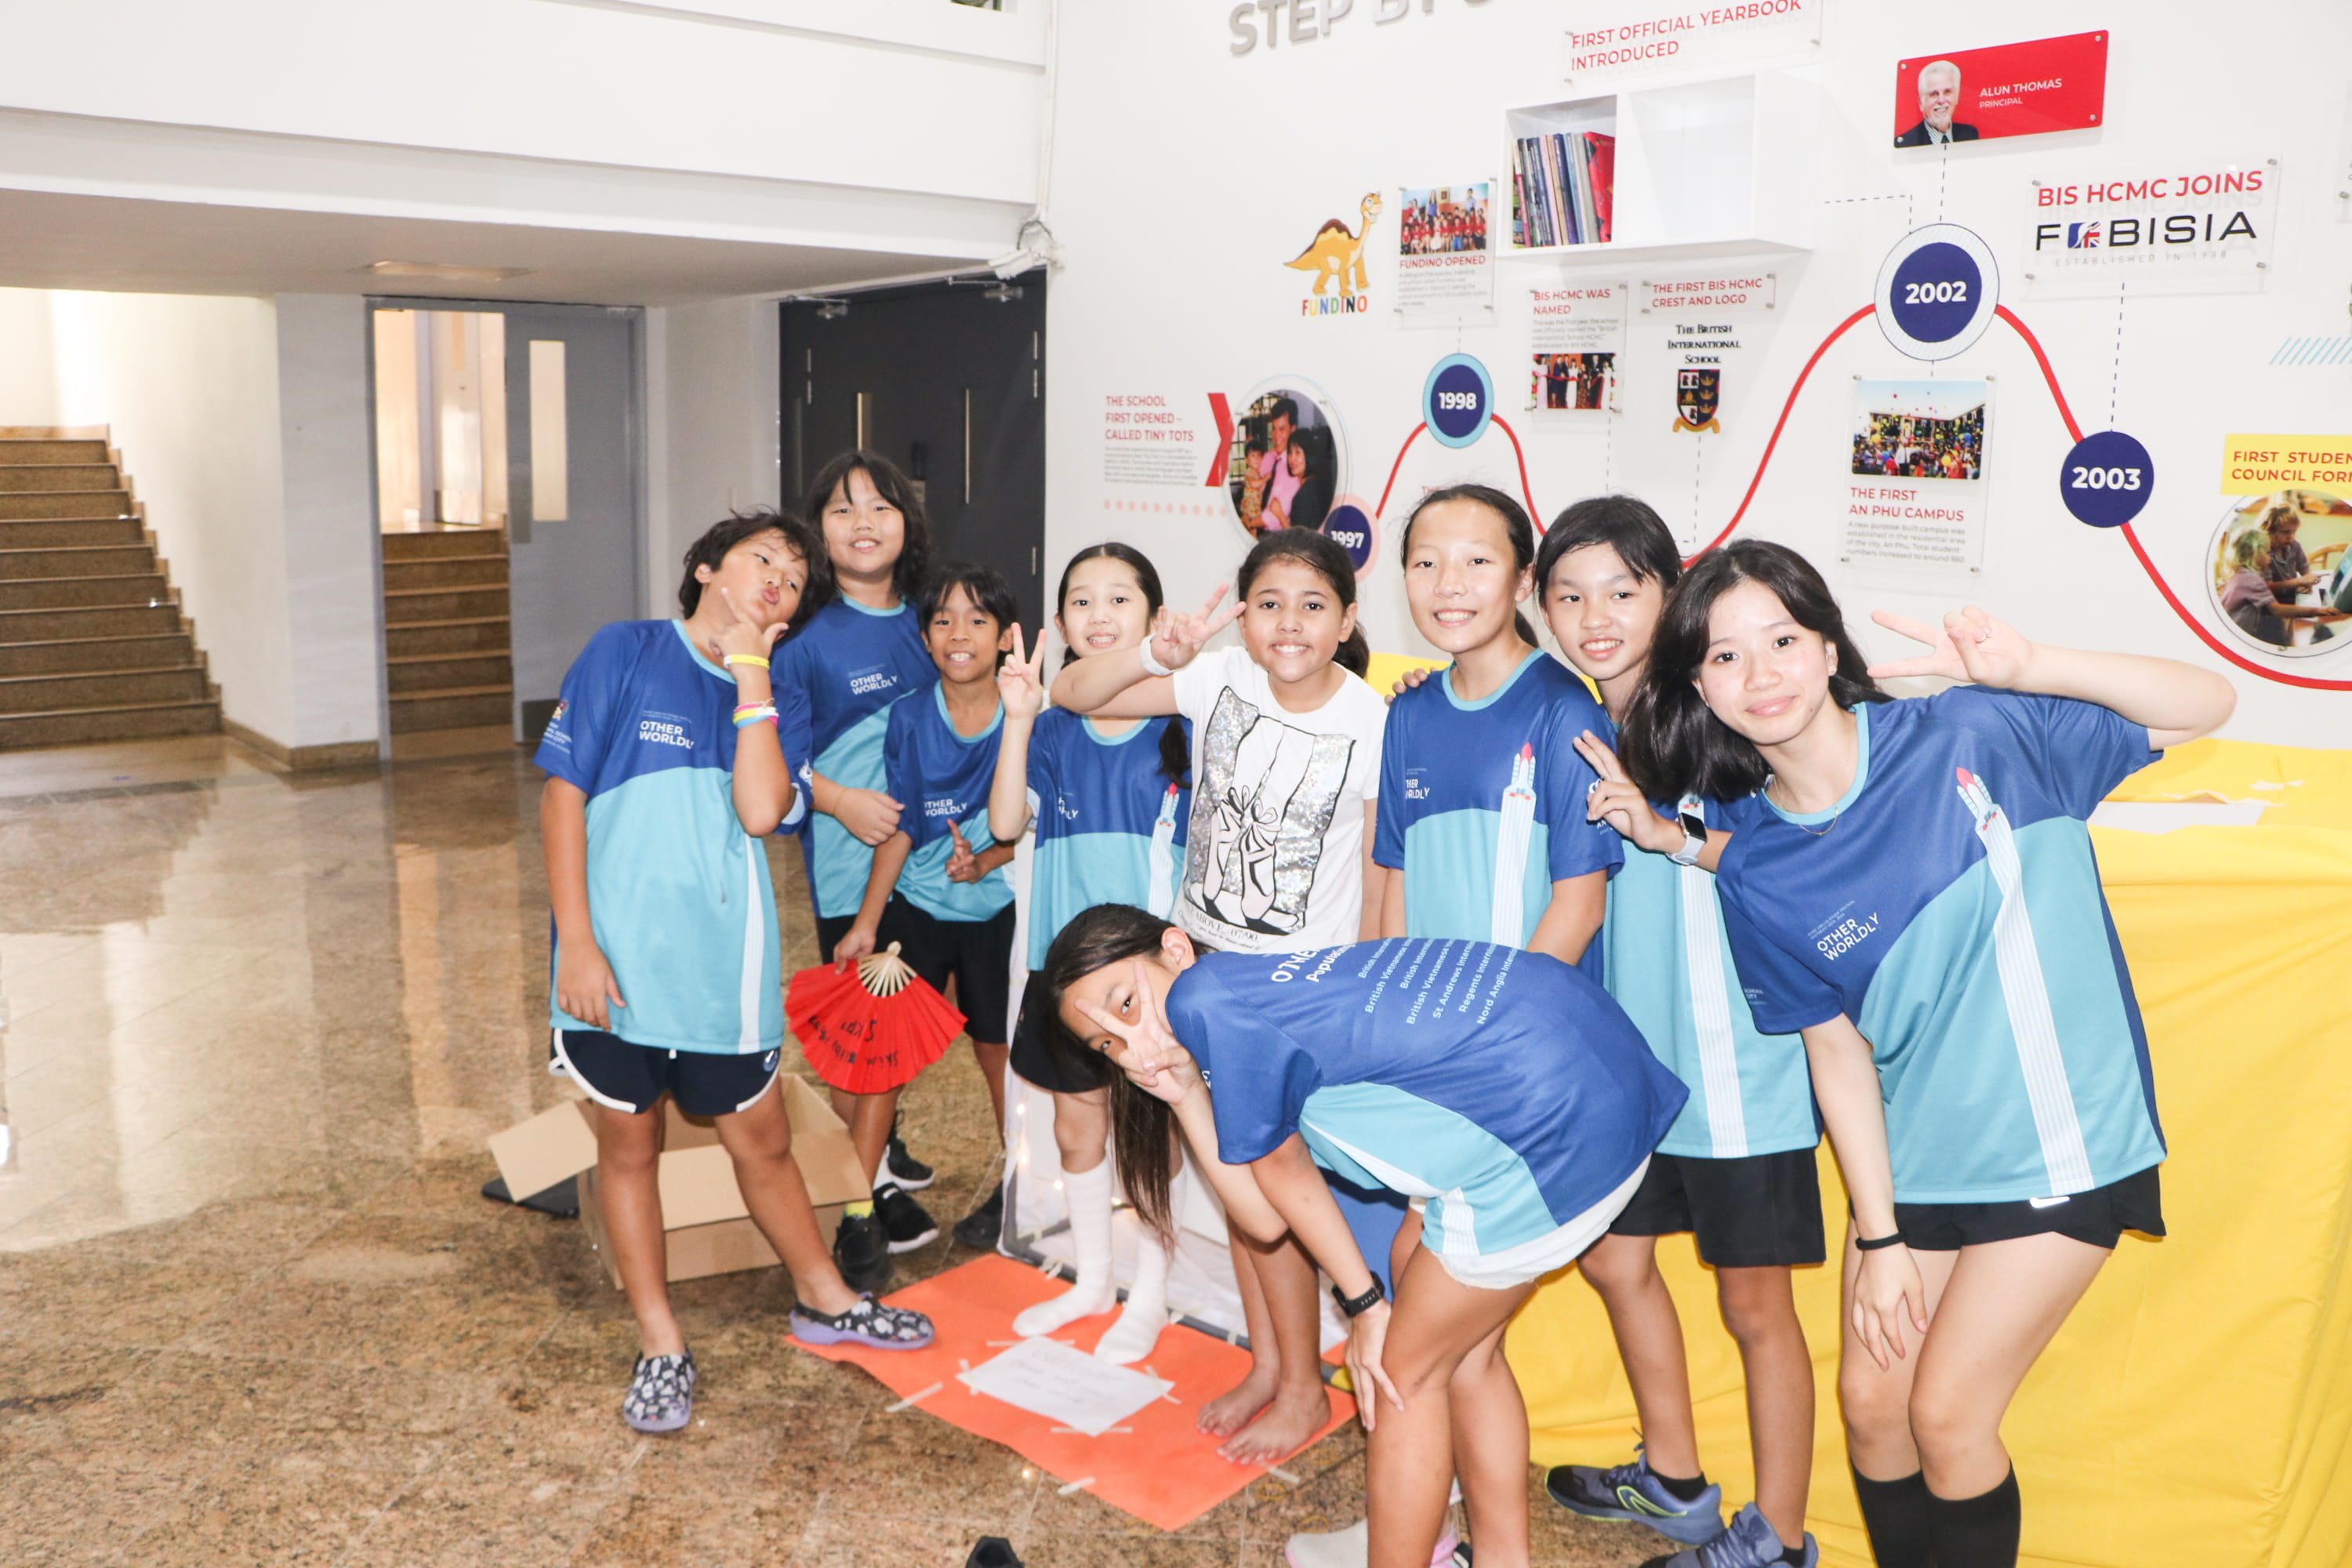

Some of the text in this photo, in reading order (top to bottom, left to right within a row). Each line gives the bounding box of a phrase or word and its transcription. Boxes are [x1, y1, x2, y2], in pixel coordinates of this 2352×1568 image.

[1229, 0, 1354, 56] STEP
[1571, 0, 1802, 49] FIRST OFFICIAL YEARBOOK
[1571, 41, 1679, 71] INTRODUCED
[1980, 78, 2063, 98] ALUN THOMAS
[1980, 96, 2023, 109] PRINCIPAL
[2038, 170, 2263, 208] BIS HCMC JOINS
[1399, 255, 1486, 269] FUNDINO OPENED
[2056, 253, 2155, 267] ESTABLISHED
[2166, 252, 2181, 262] IN
[1534, 289, 1611, 301] BIS HCMC WAS
[1653, 278, 1763, 294] THE FIRST BIS HCMC
[1905, 280, 1968, 305] 2002
[1302, 294, 1368, 317] FUNDINO
[1534, 304, 1572, 315] NAMED
[1652, 294, 1747, 308] CREST AND LOGO
[1105, 395, 1167, 407] THE SCHOOL
[1439, 392, 1477, 410] 1998
[1105, 412, 1131, 423] FIRST
[1134, 412, 1175, 424] OPENED
[1105, 429, 1194, 442] CALLED TINY TOTS
[2233, 451, 2280, 463] FIRST
[2071, 466, 2141, 491] 2003
[2231, 468, 2352, 483] COUNCIL FOR
[1850, 487, 1918, 502] THE FIRST
[1849, 504, 1965, 521] AN PHU CAMPUS
[1330, 530, 1365, 550] 1997
[850, 673, 883, 688] OTHER
[851, 675, 898, 695] WORLDLY
[640, 720, 684, 736] OTHER
[924, 798, 953, 810] THER
[1817, 918, 1859, 952] OTHER
[1824, 912, 1879, 961] WORLDLY
[1271, 950, 1321, 982] OTHE
[1399, 964, 1419, 989] British
[1406, 991, 1428, 1025] British
[1421, 947, 1450, 989] Vietnamese
[1364, 980, 1386, 1014] British
[1432, 1007, 1444, 1019] St
[1439, 966, 1463, 1006] Andrews
[1458, 974, 1482, 1013] Regents
[1476, 998, 1494, 1025] Nord
[1490, 971, 1507, 998] Anglia
